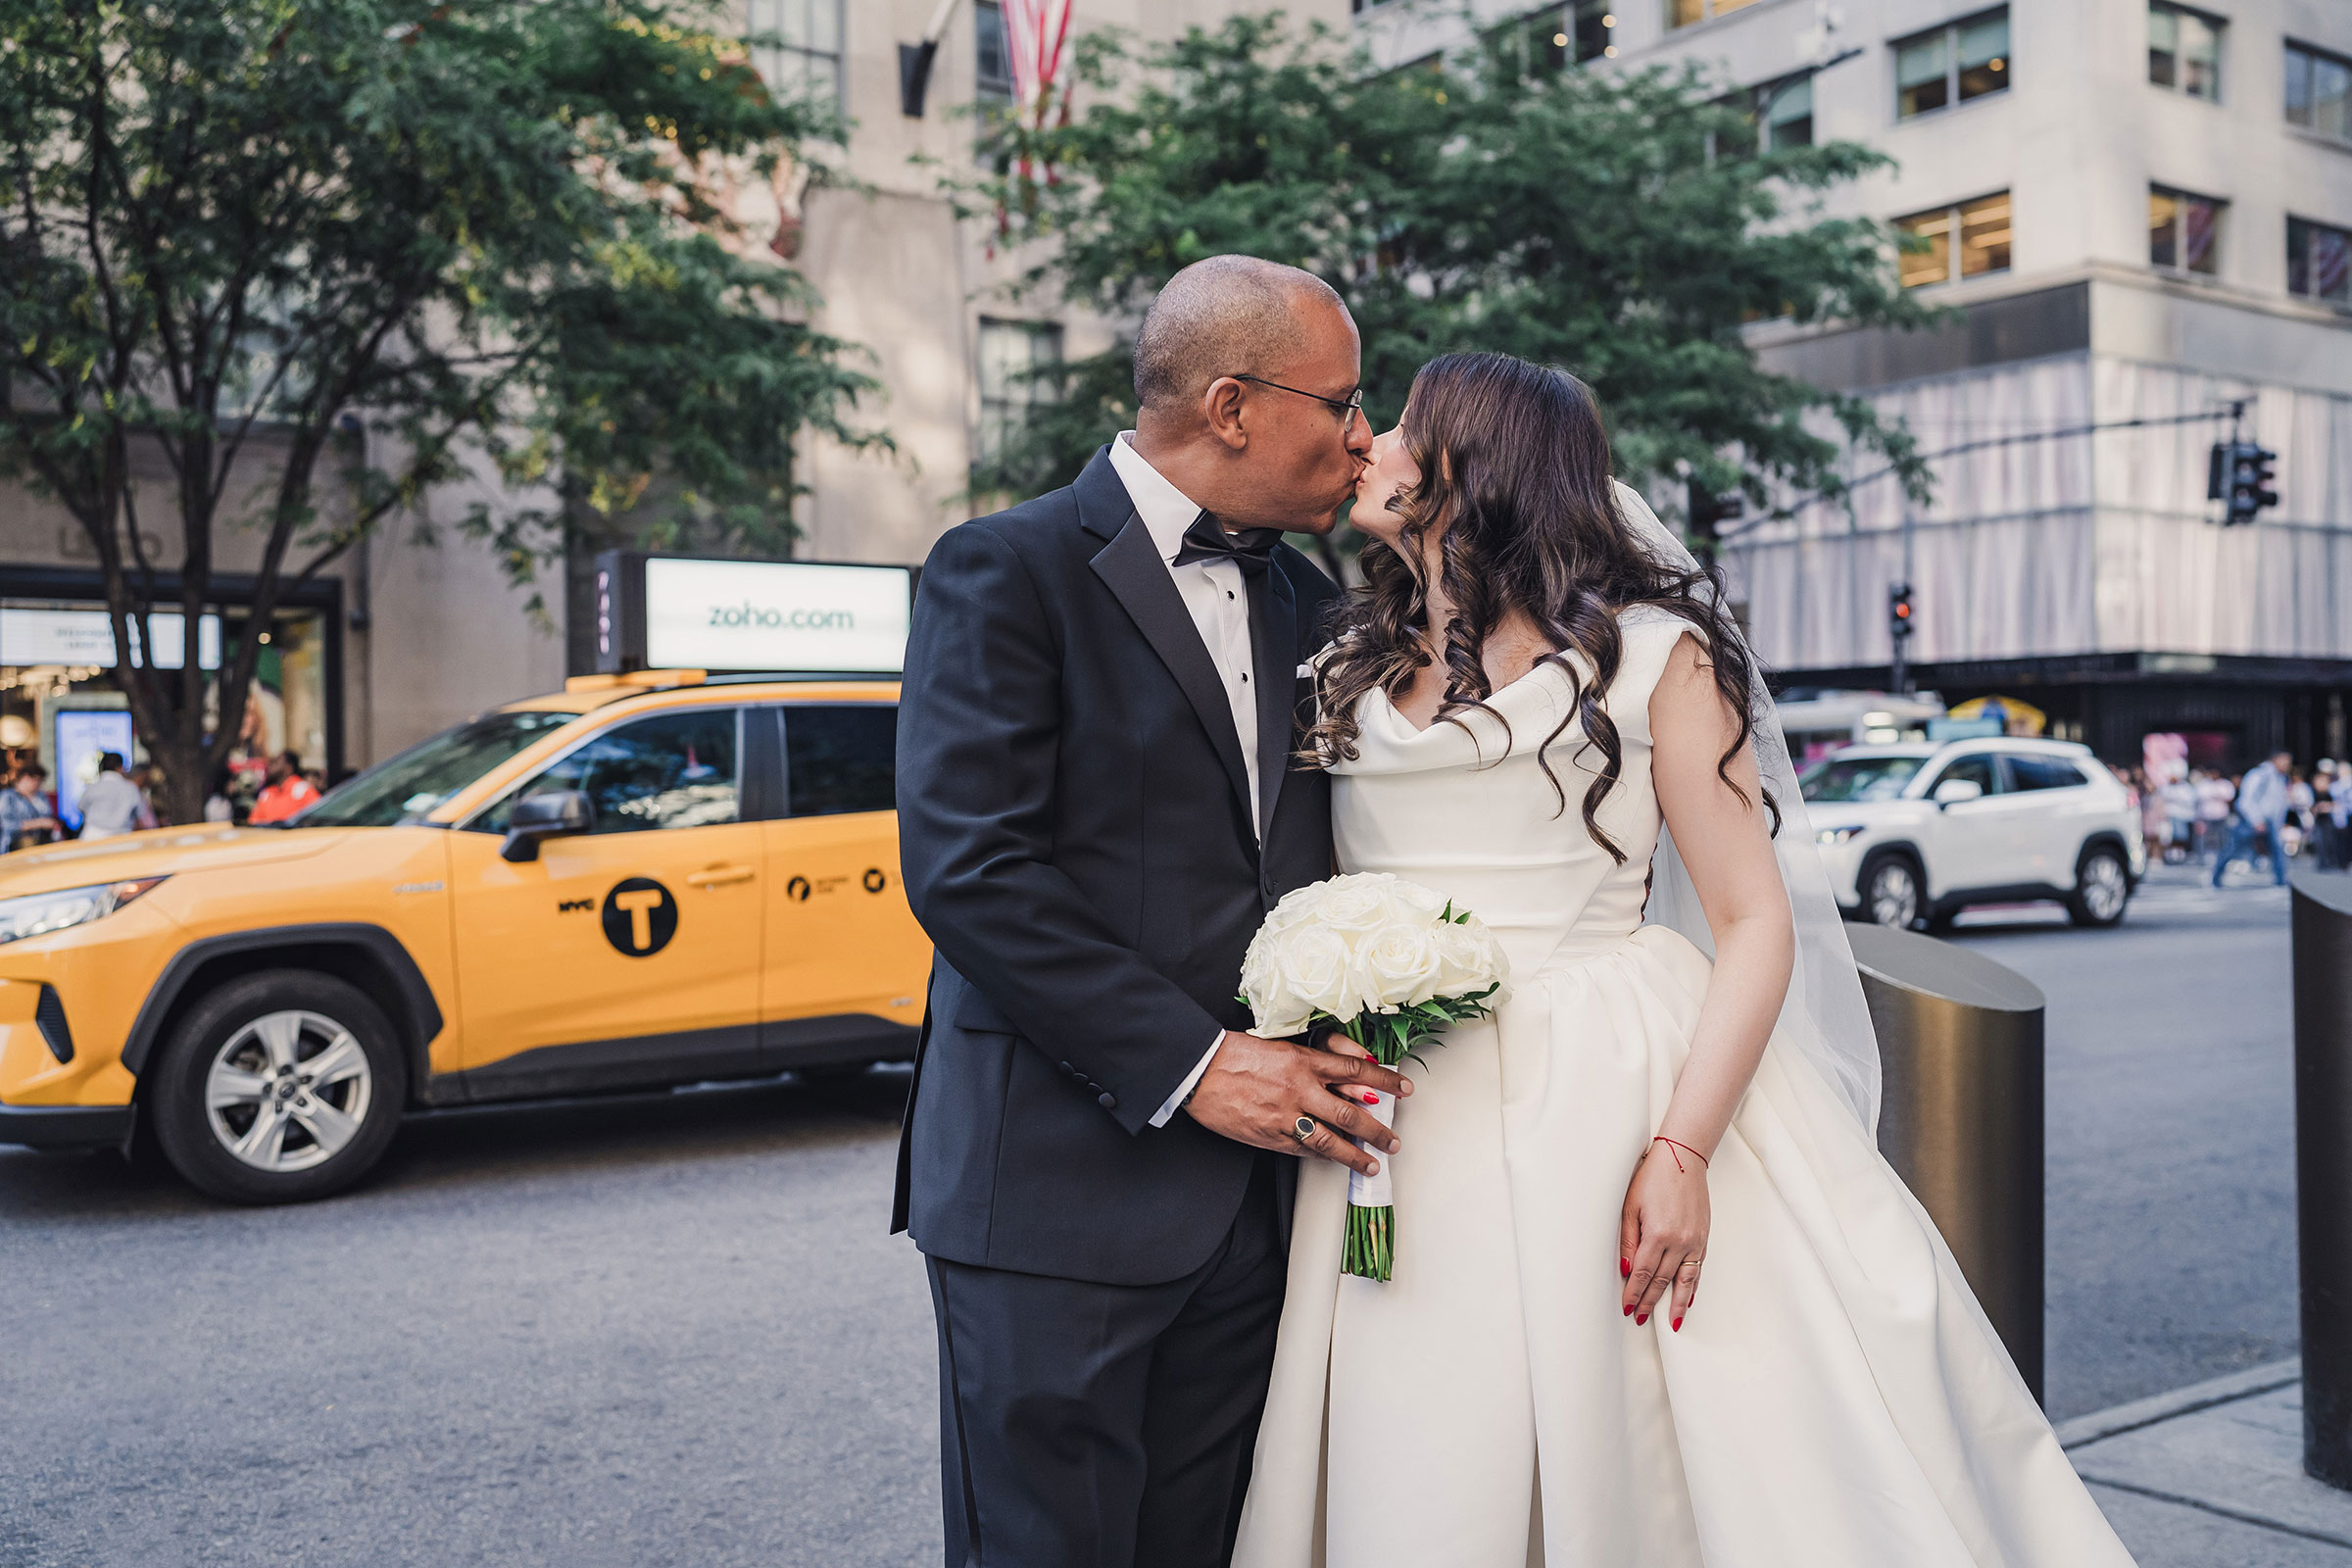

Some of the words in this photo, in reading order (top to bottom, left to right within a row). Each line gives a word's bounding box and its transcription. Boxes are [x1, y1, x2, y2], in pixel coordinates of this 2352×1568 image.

[709, 598, 855, 629] zoho.com
[559, 899, 594, 911] NYC
[615, 889, 662, 951] T
